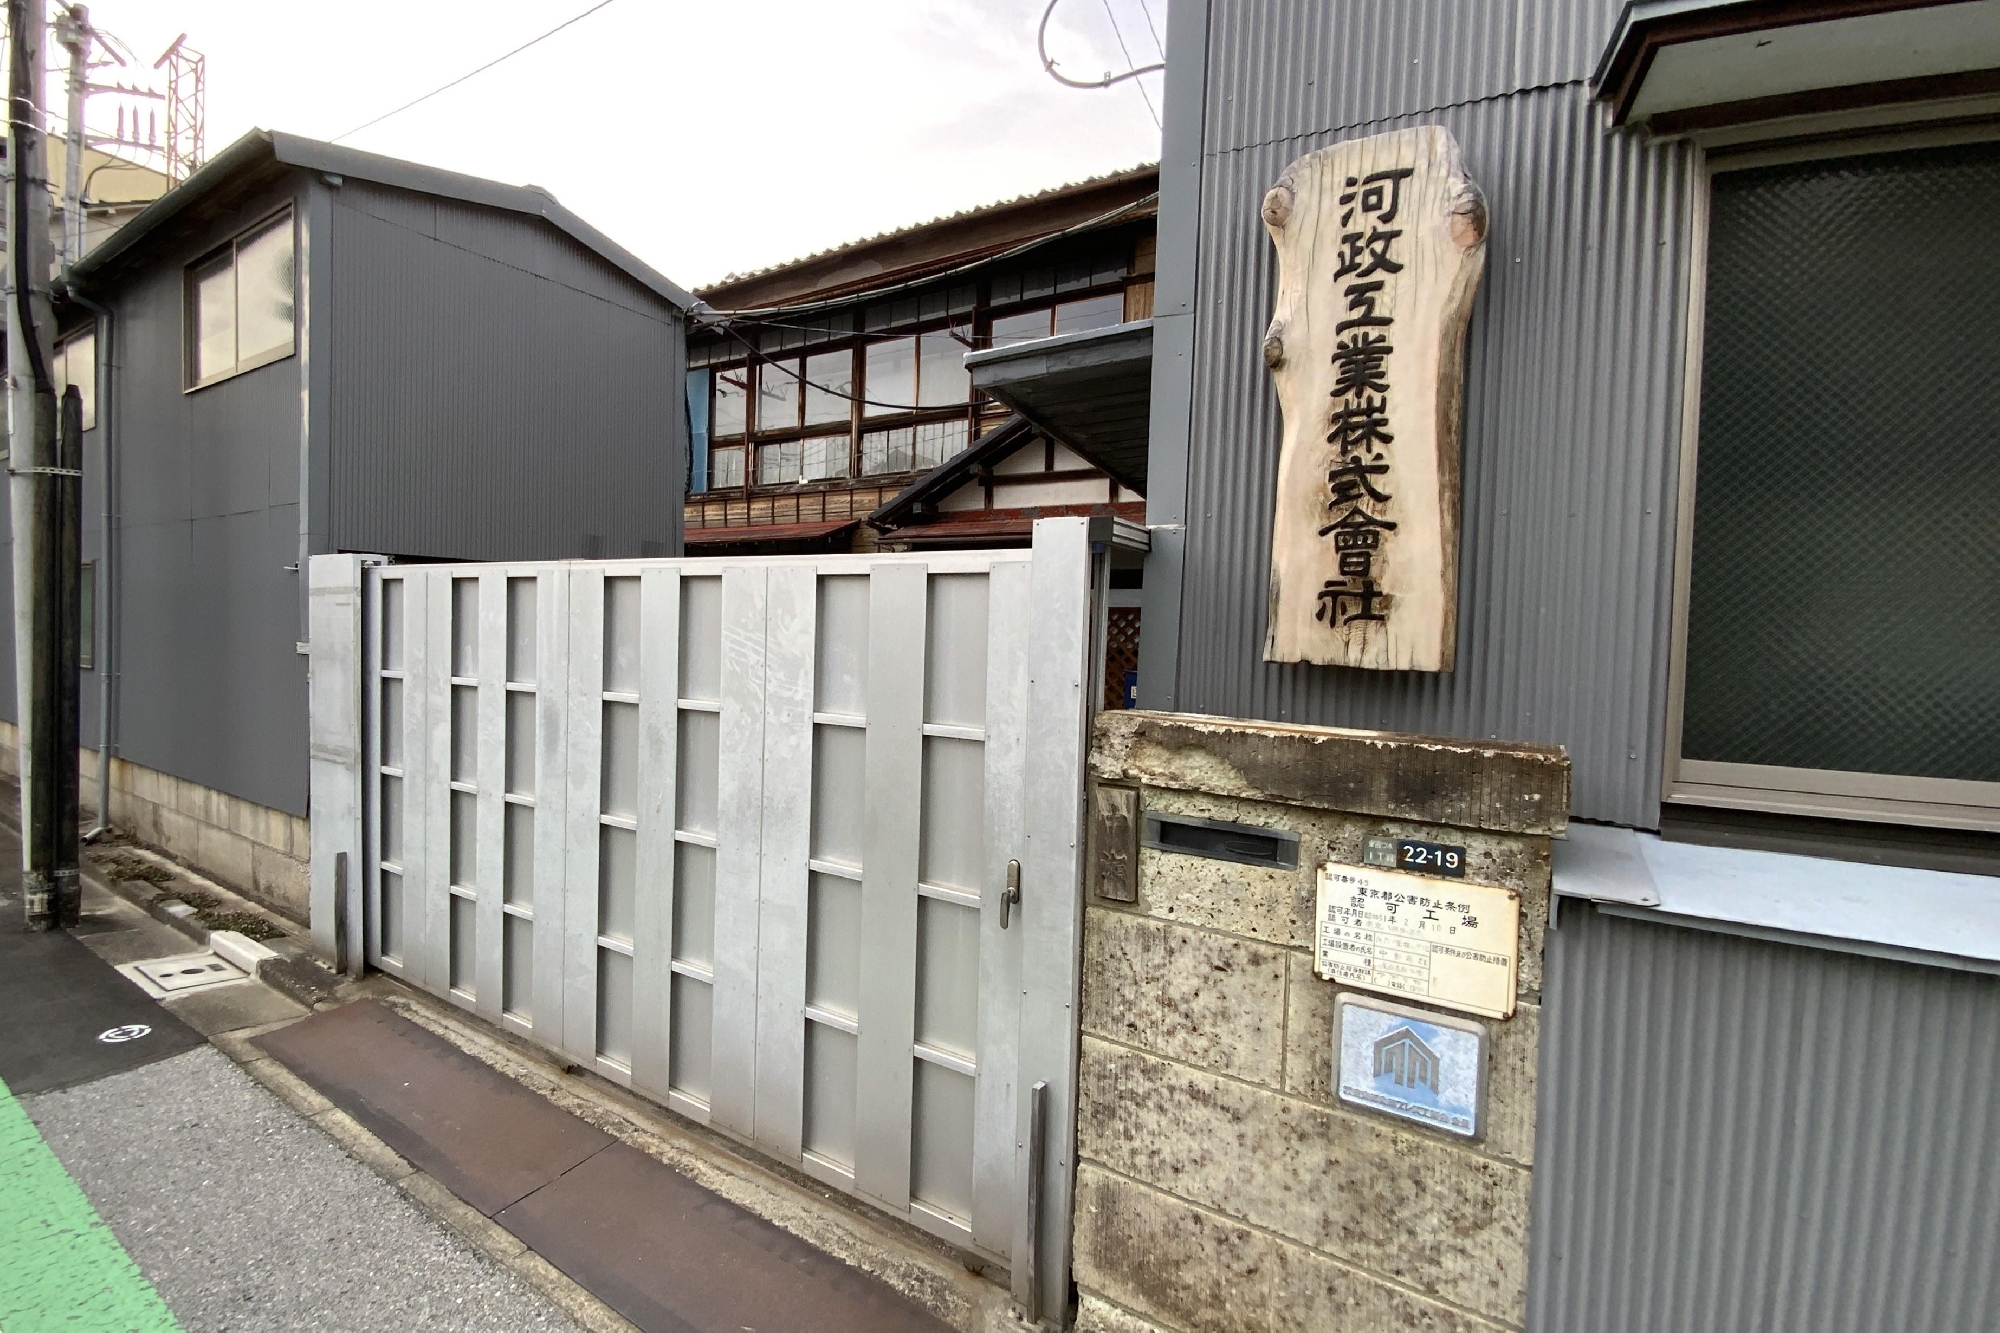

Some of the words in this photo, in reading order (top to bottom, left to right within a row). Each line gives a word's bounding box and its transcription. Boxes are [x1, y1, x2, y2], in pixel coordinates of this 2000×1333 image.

[1403, 845, 1459, 869] 22-19
[1357, 886, 1471, 914] 東京都公害防止条例
